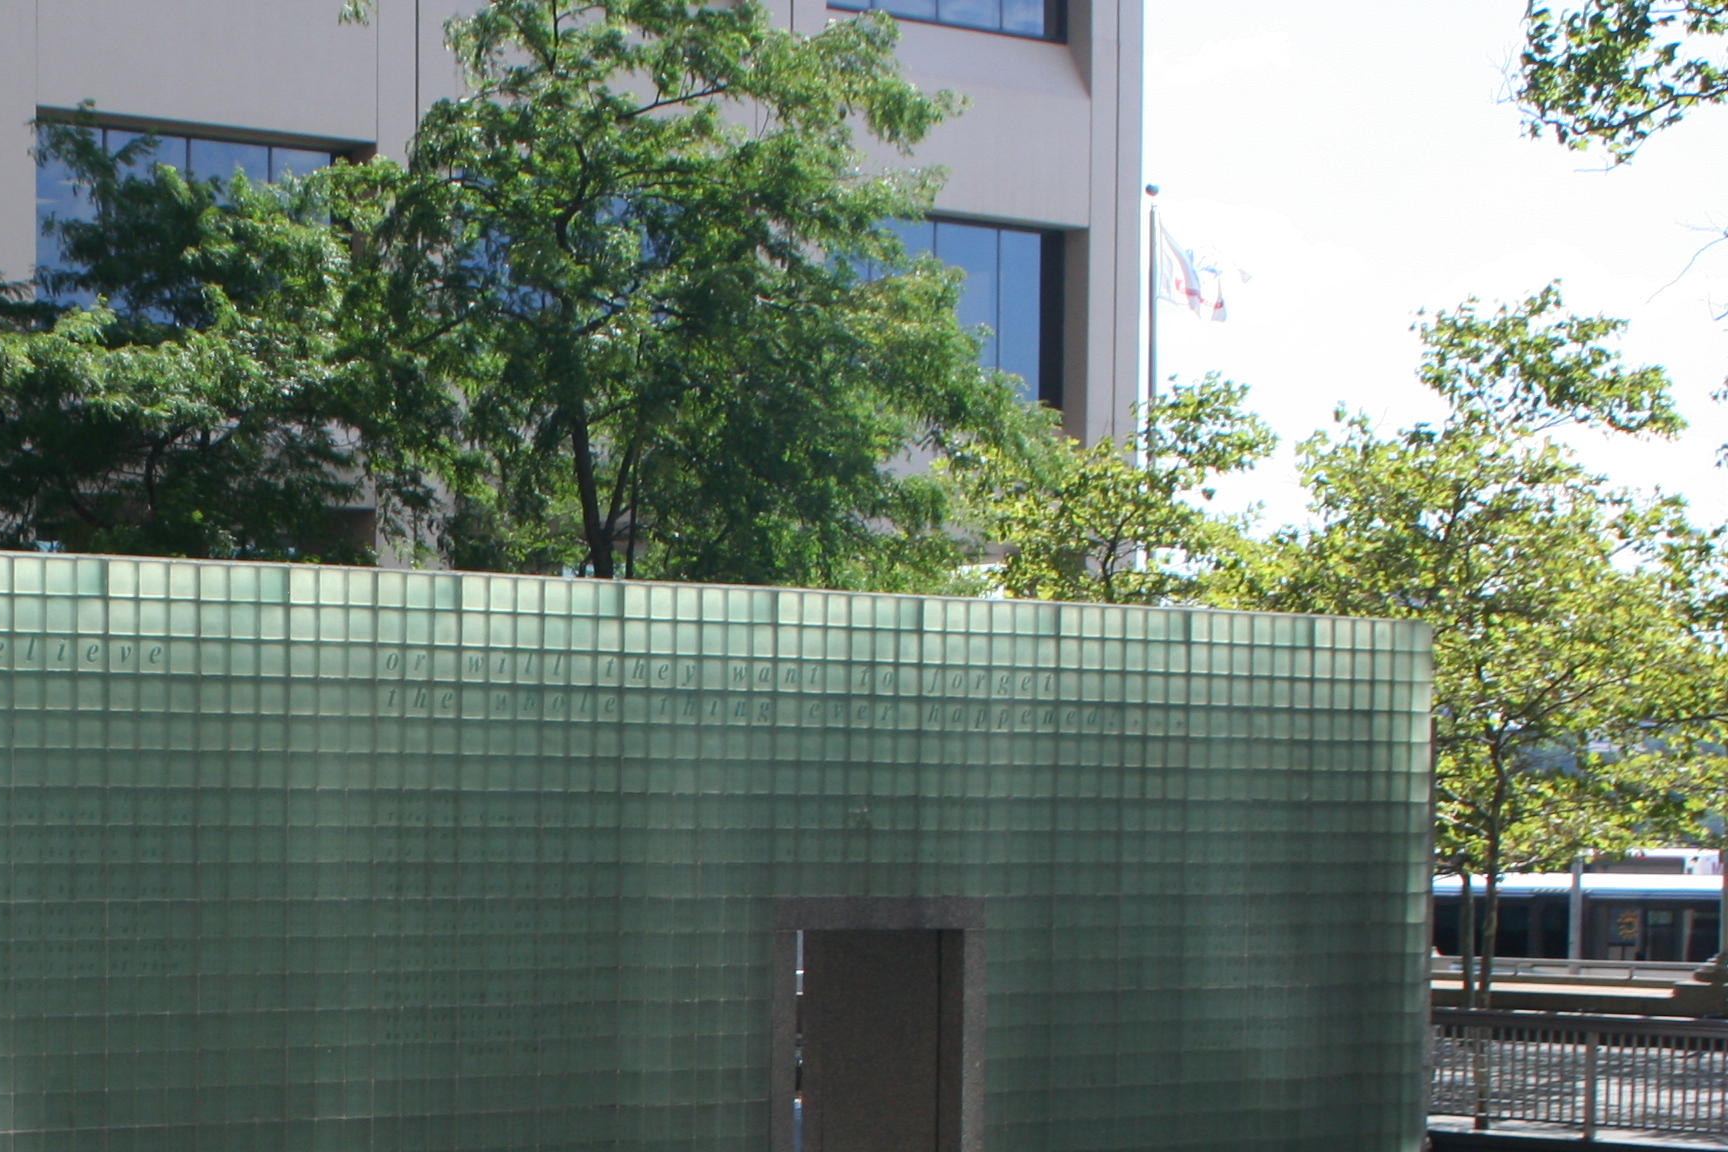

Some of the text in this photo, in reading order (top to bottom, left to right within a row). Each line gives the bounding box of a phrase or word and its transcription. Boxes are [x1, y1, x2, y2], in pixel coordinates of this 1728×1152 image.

[384, 652, 1054, 695] or will they want to forget
[387, 686, 454, 710] the
[495, 690, 616, 714] whole
[659, 693, 769, 722] thing
[808, 700, 893, 722] ever
